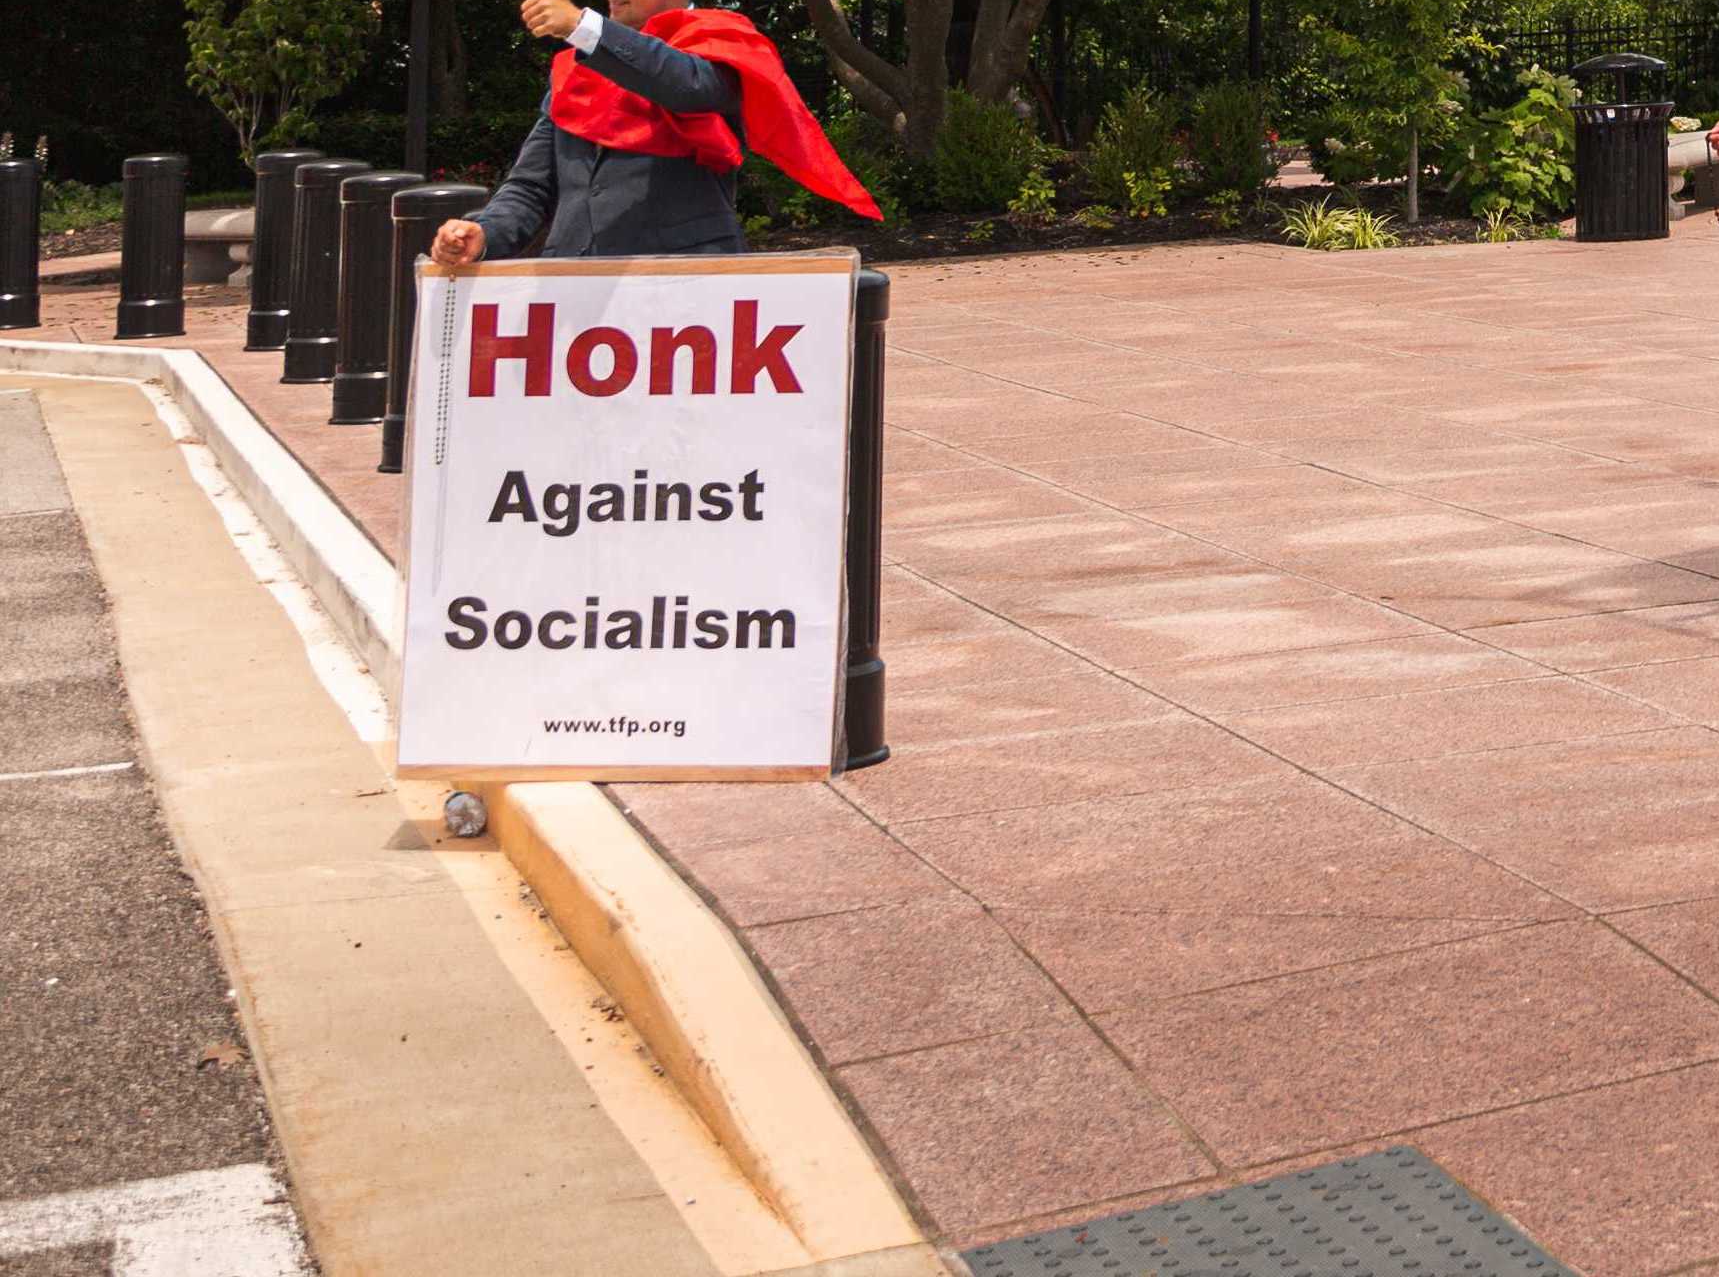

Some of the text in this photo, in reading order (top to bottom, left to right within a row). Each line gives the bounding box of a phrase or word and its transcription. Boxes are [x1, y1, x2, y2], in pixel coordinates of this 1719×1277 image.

[468, 299, 805, 398] Honk
[487, 468, 765, 538] Against
[444, 595, 796, 651] Socialism
[544, 716, 687, 738] www.tfp.org
